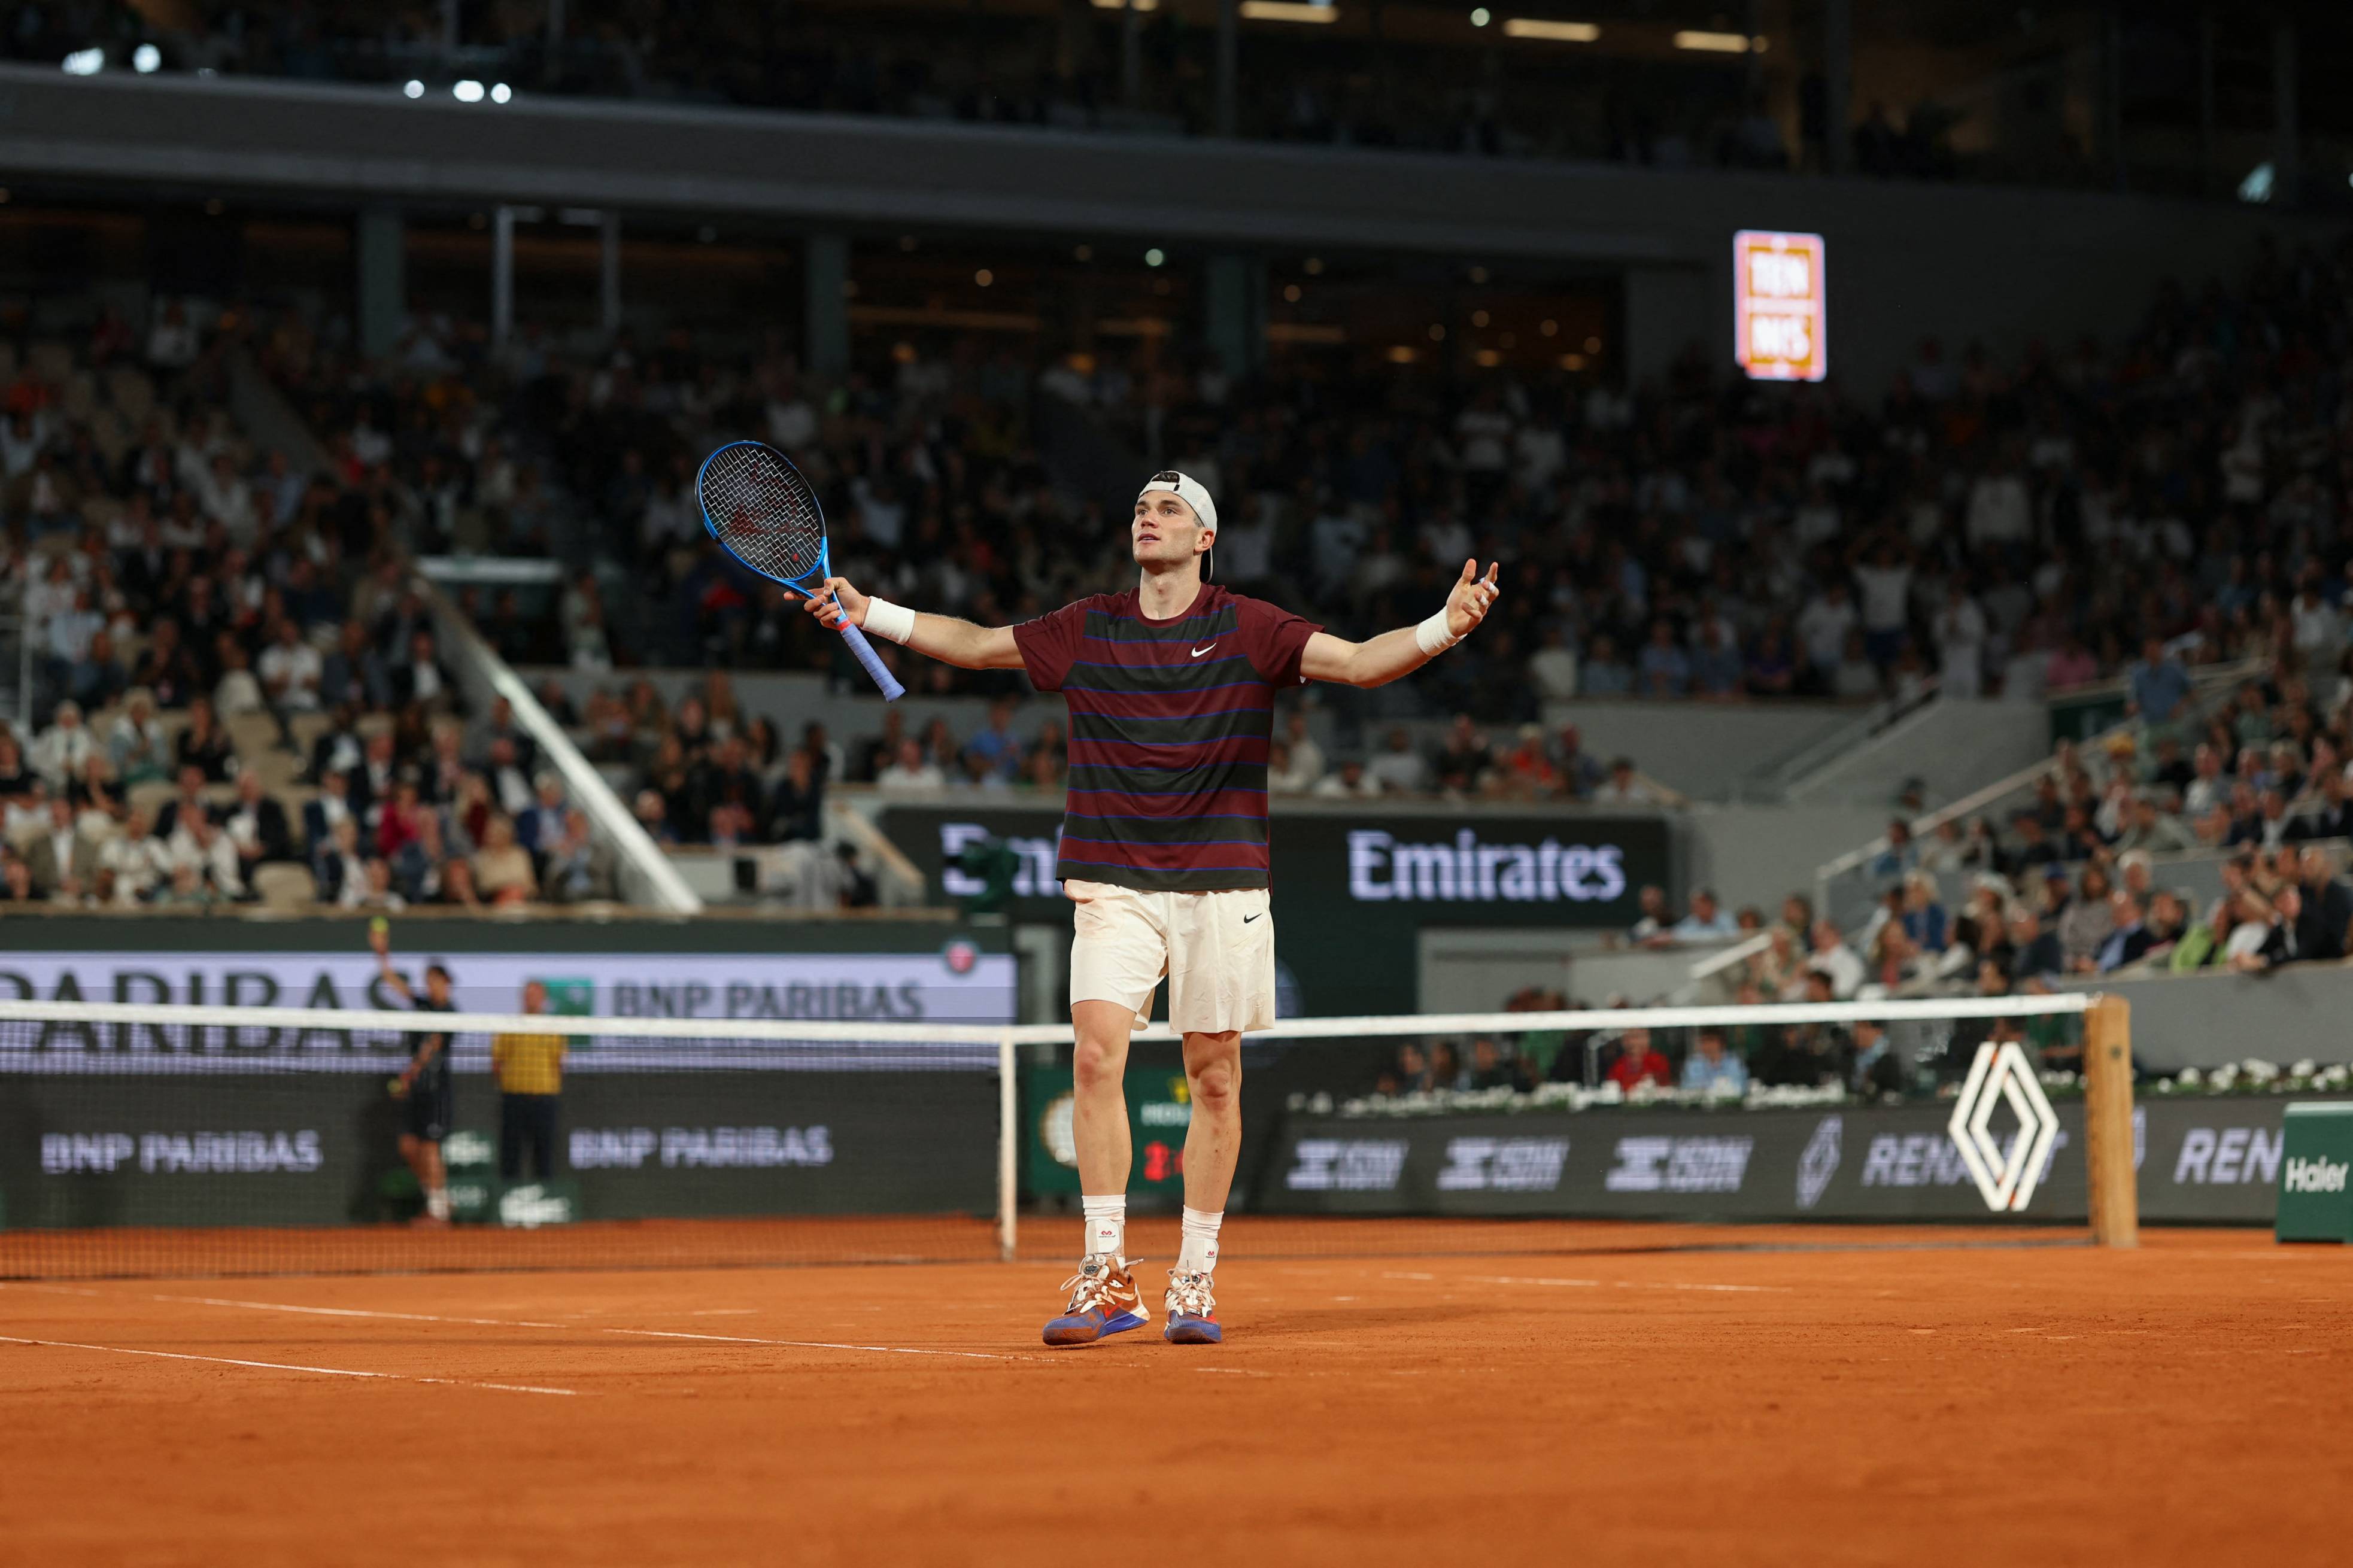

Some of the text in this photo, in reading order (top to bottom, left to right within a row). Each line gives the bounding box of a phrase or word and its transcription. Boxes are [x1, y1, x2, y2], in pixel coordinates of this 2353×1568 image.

[1347, 828, 1626, 901] Emirates
[612, 979, 924, 1020] BNP PARIBAS
[41, 1130, 323, 1174] BNP PARIBAS
[569, 1125, 833, 1168] BNP PARIBAS
[2173, 1127, 2285, 1184] REN
[2284, 1155, 2349, 1193] Haier
